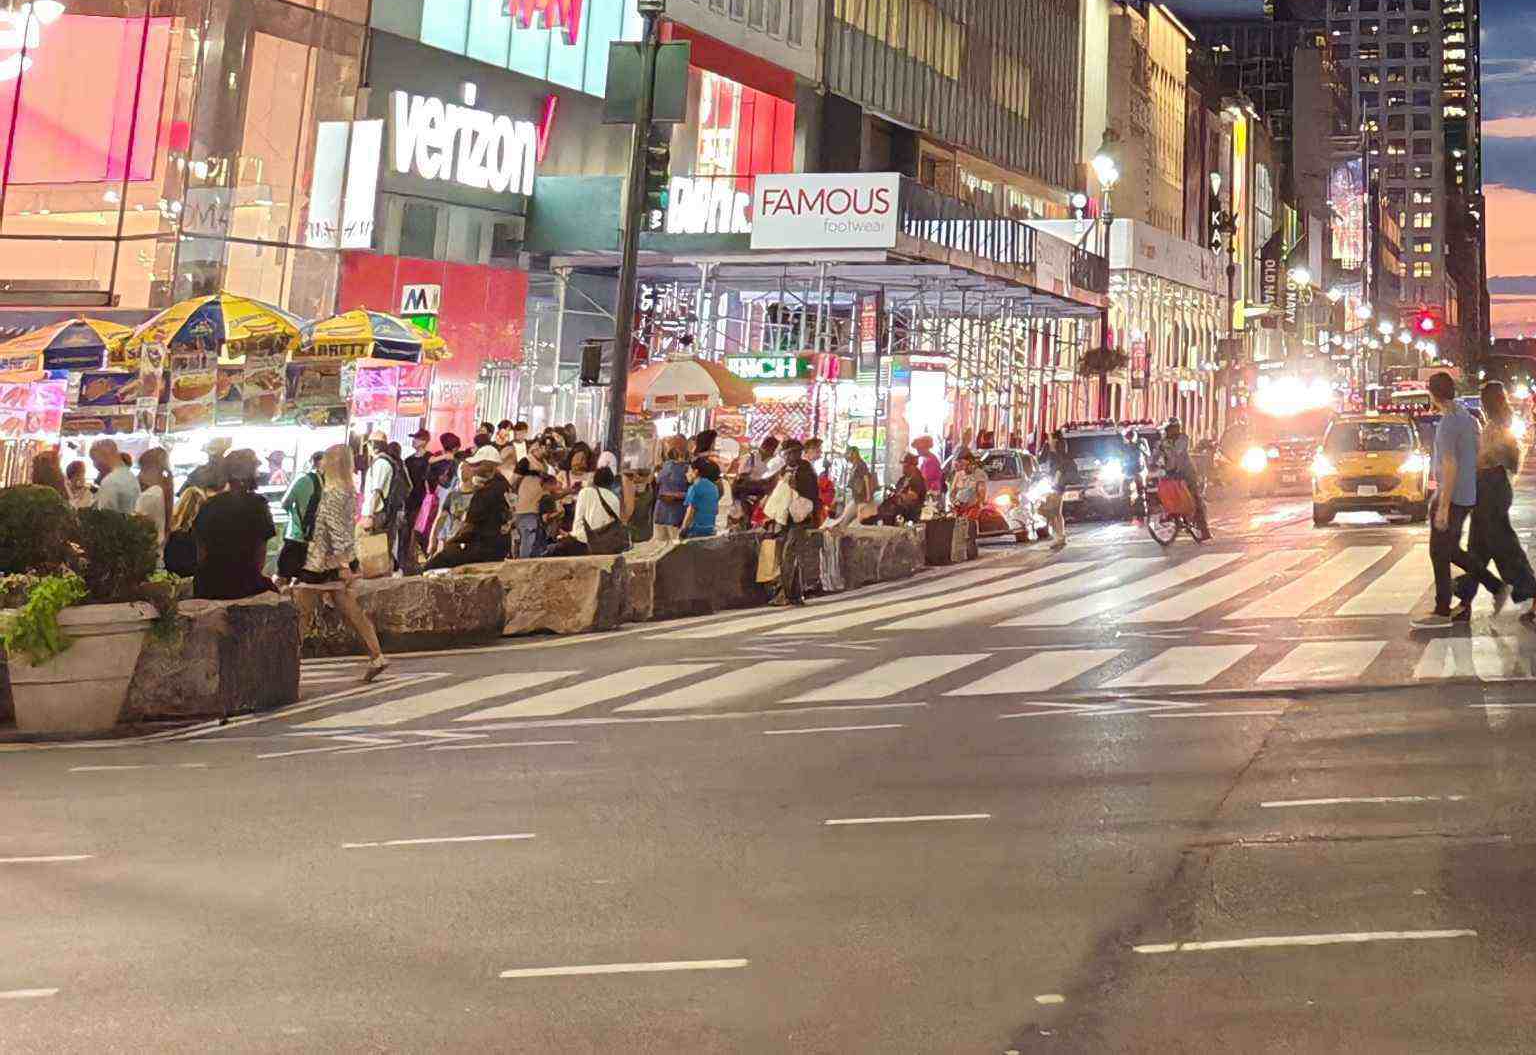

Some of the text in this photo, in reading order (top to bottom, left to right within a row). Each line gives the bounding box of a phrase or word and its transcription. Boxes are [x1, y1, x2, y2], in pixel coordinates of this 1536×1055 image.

[391, 81, 537, 196] verizon
[761, 187, 890, 216] FAMOUS
[824, 217, 885, 233] footwear
